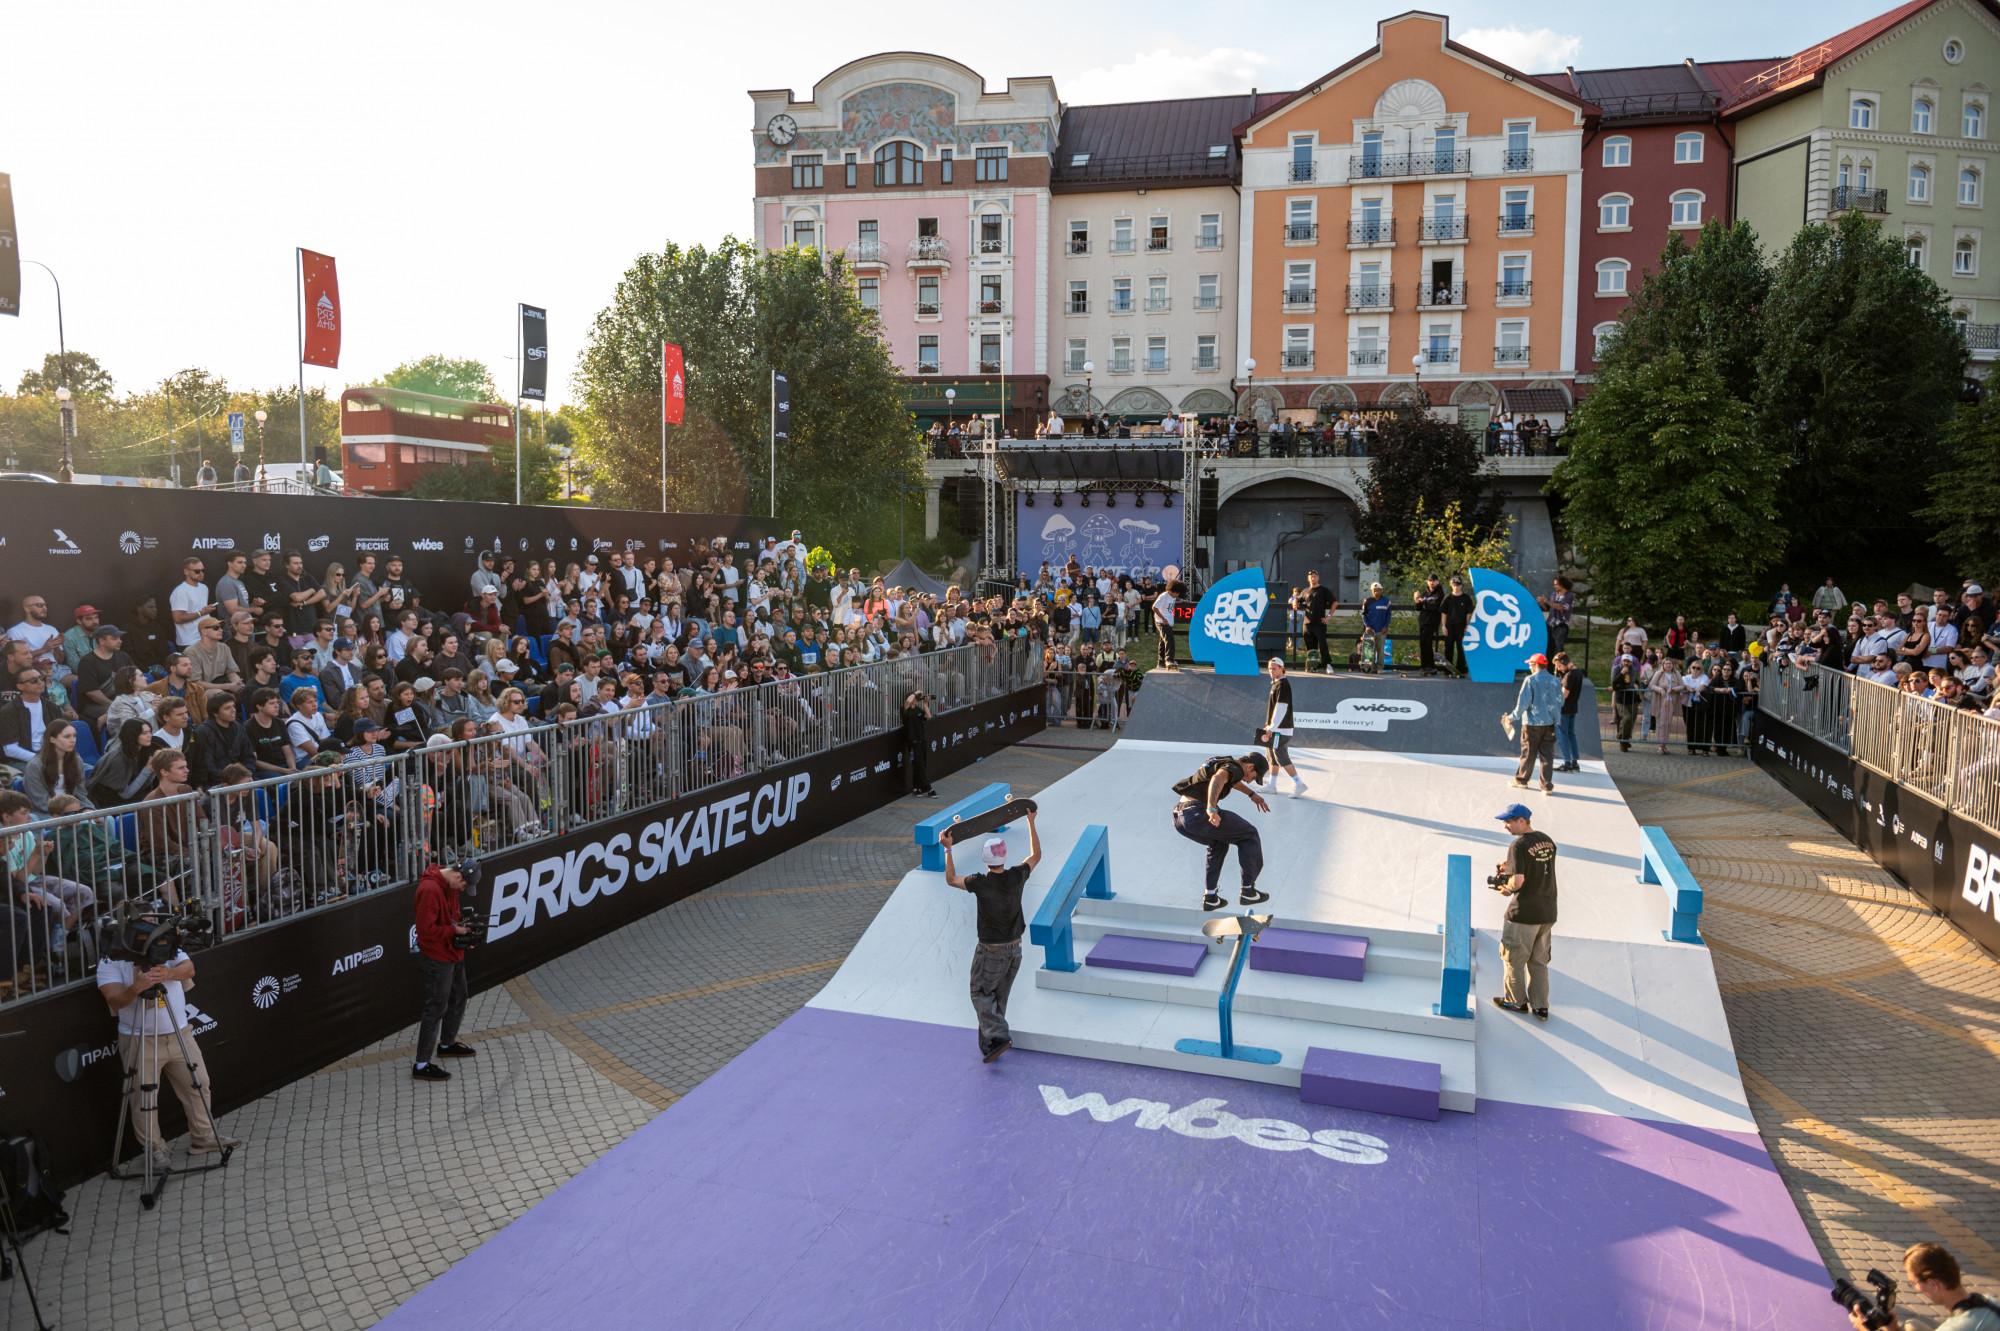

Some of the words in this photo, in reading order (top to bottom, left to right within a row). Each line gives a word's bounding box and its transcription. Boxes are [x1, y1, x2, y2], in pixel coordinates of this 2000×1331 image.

[192, 538, 218, 549] АПР
[1470, 590, 1521, 623] CS
[487, 833, 632, 944] BRICS
[635, 791, 750, 882] SKATE
[752, 771, 811, 836] CUP
[332, 951, 362, 976] АПР
[191, 1021, 218, 1036] КОЛОР
[81, 1041, 120, 1067] ПРАЙ
